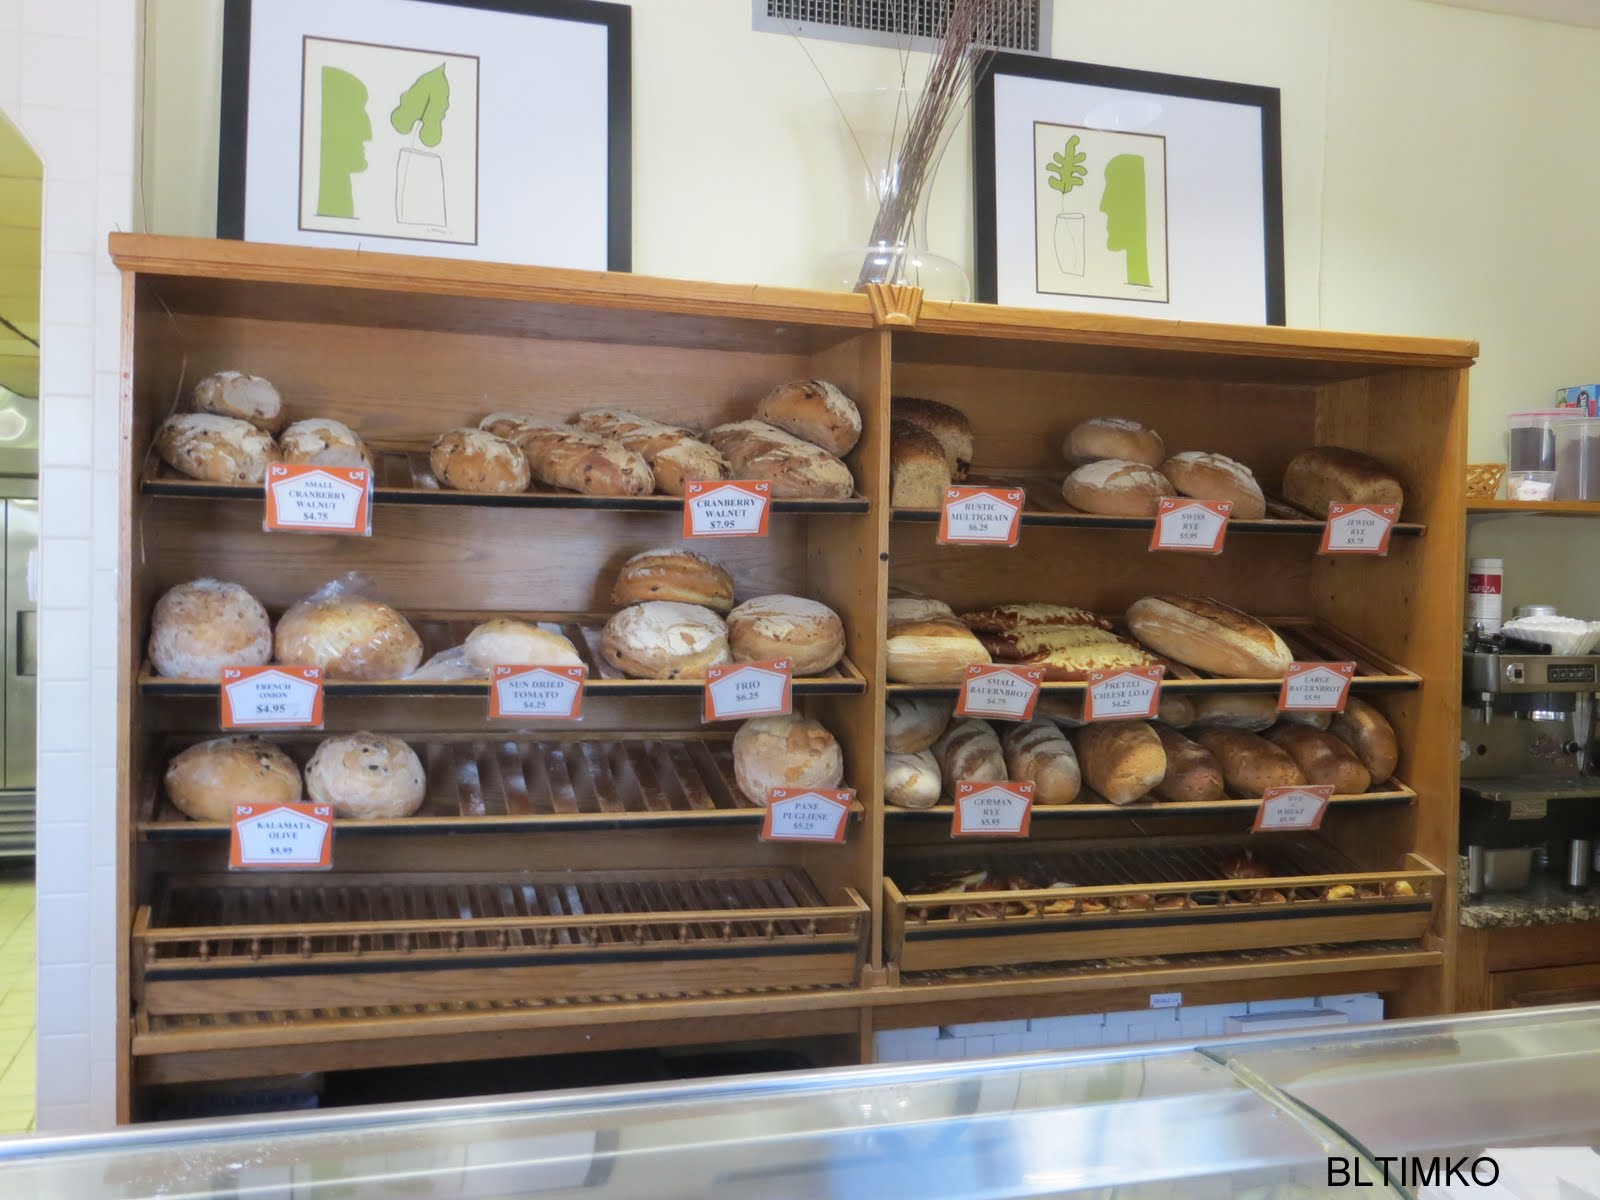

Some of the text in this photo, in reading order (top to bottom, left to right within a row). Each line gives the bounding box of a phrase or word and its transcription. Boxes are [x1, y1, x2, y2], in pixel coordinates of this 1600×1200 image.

[288, 489, 346, 500] CRANBERRY
[296, 501, 338, 509] WALNUT
[696, 498, 757, 508] CRANBERRY
[964, 503, 997, 511] RUSTIC
[303, 512, 329, 521] $4.75
[705, 509, 747, 518] WALNUT
[951, 513, 1009, 521] MULTIGRAIN
[709, 520, 735, 529] $7.95
[1346, 519, 1376, 527] JEWISH
[1179, 532, 1199, 540] $5.95
[1468, 585, 1497, 593] AFIZA
[736, 680, 760, 691] TRIO
[987, 678, 1016, 687] SMALL
[1104, 681, 1142, 690] PRETZEL
[256, 683, 292, 691] FRENCH
[1289, 685, 1341, 693] BAUERNBROT
[513, 691, 559, 699] TOMATO
[970, 686, 1029, 698] BAUERNBROT
[1094, 689, 1151, 700] CHEESE LOAF
[736, 692, 760, 702] $6.25
[523, 701, 547, 709] $4.25
[1112, 700, 1131, 708] $4.25
[256, 704, 286, 714] $4.95
[782, 812, 829, 820] PUGLIESE
[793, 822, 814, 830] $5.25
[270, 847, 293, 855] $5.95
